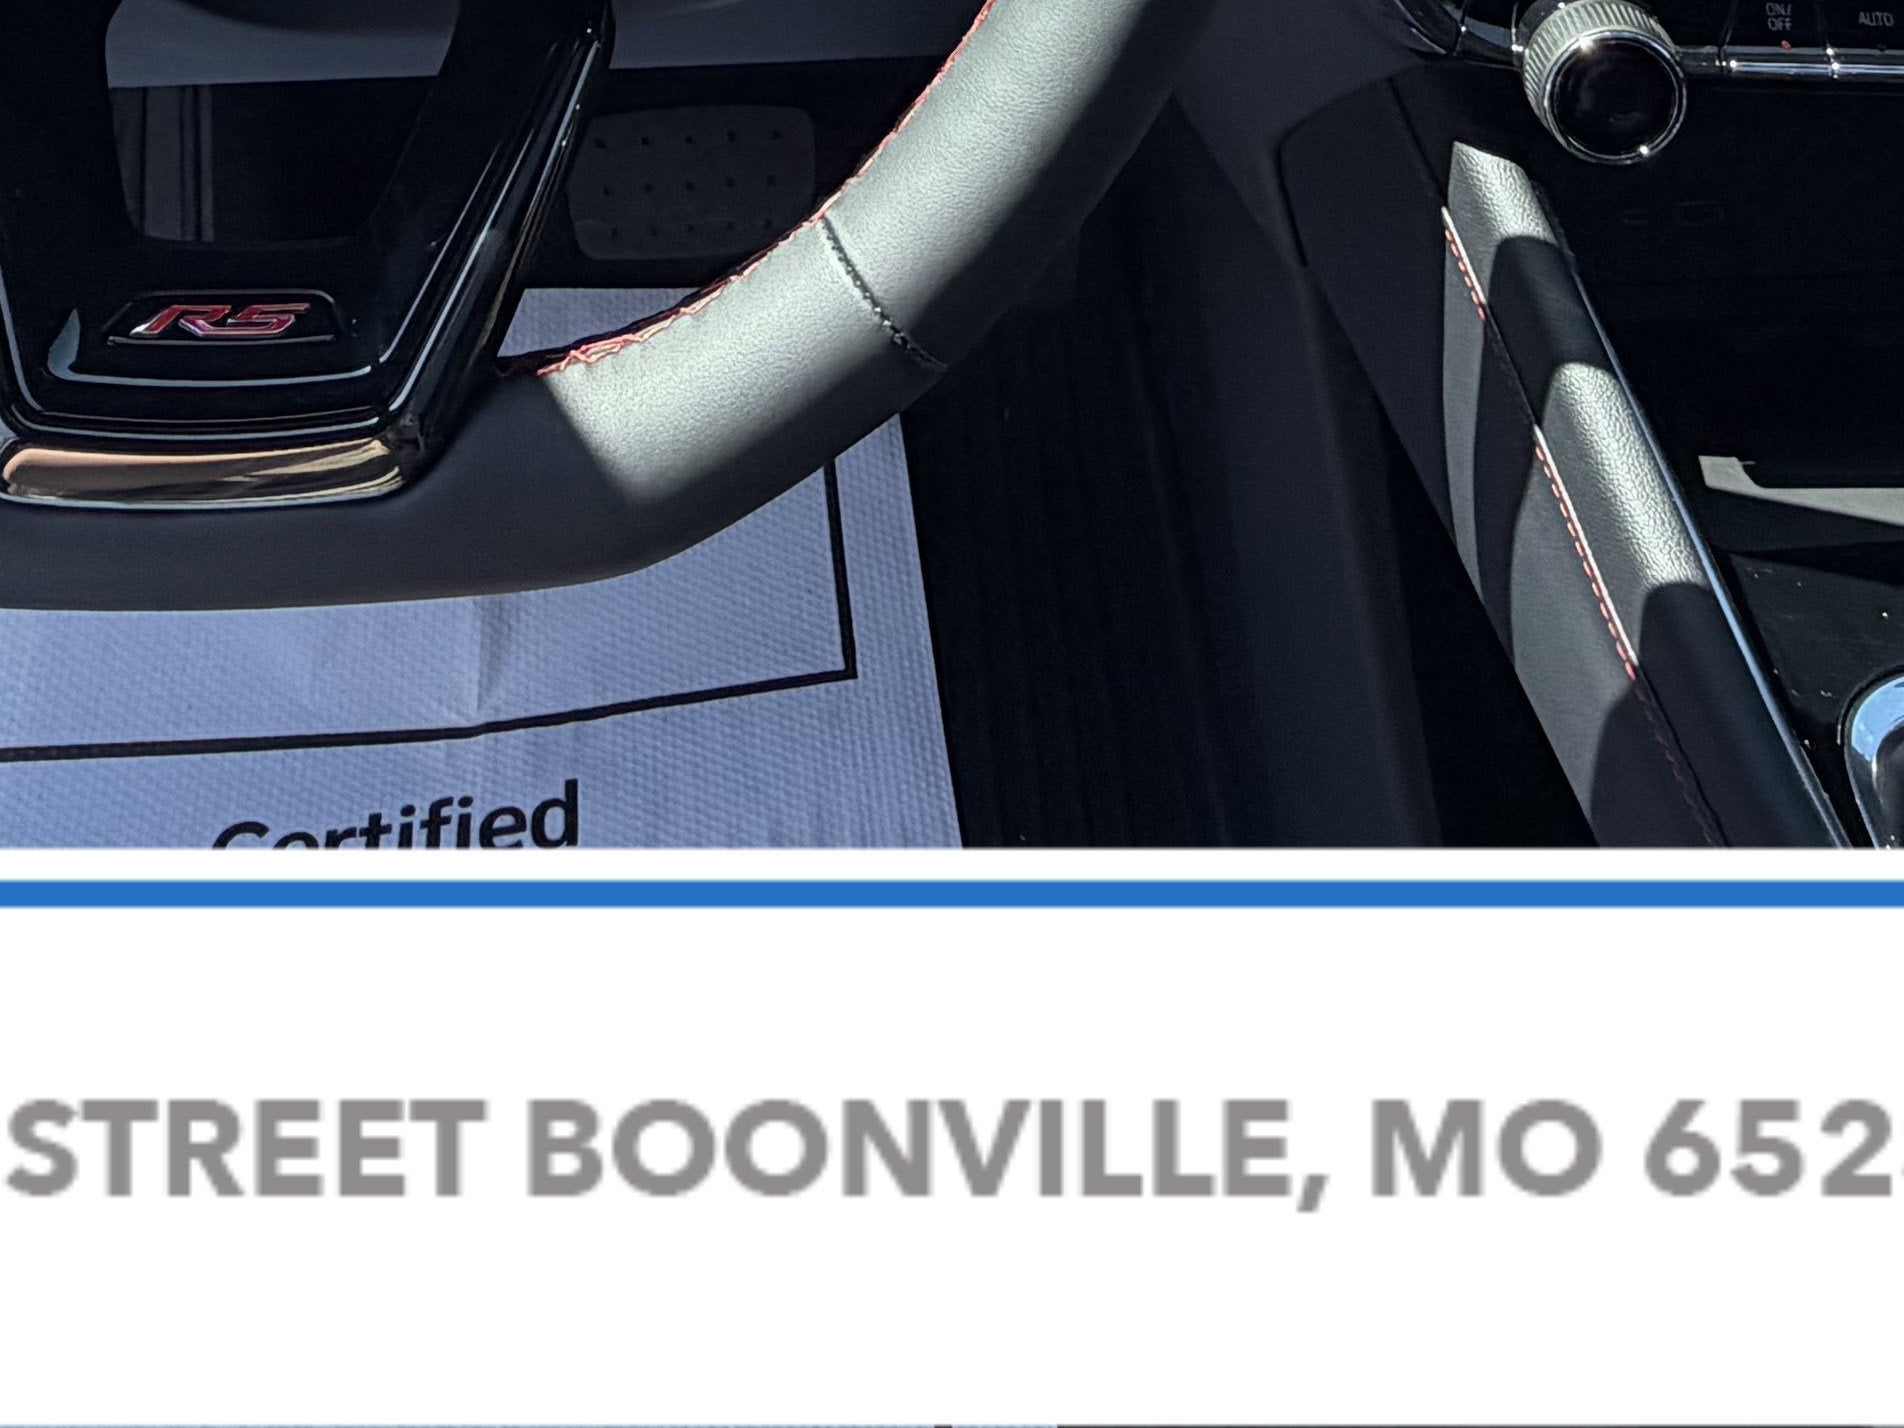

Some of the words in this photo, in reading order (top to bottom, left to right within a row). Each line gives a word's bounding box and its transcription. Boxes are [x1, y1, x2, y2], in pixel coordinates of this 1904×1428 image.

[1767, 17, 1792, 32] OFF
[1857, 11, 1895, 27] AUTO
[129, 303, 311, 339] RS
